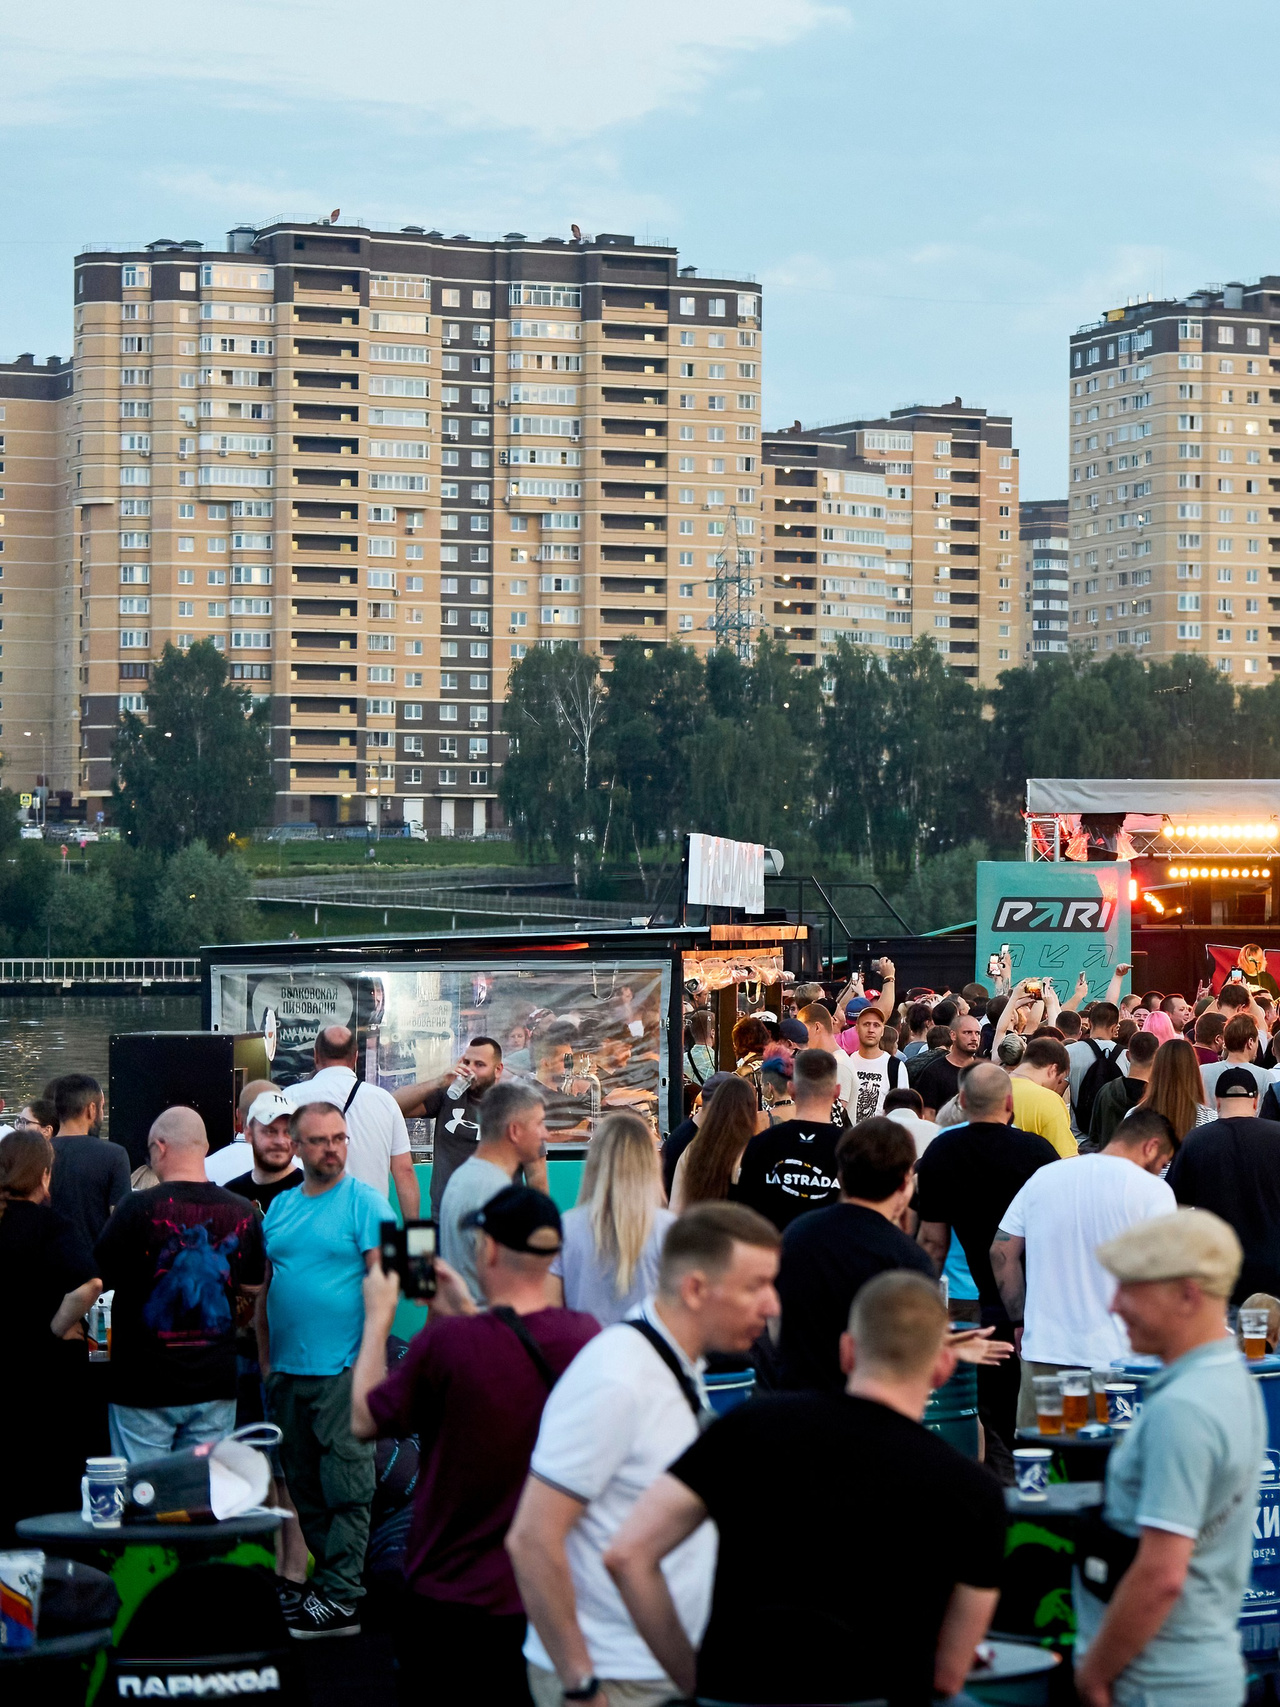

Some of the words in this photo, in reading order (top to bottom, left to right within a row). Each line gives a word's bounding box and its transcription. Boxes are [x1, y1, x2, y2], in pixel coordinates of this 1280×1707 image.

[996, 901, 1112, 928] PARI
[281, 986, 338, 1000] ВОЛКОВСКАЯ
[282, 1001, 336, 1014] ПИВОВАРНЯ
[765, 1173, 781, 1184] LA
[783, 1173, 841, 1189] STRADA
[117, 1665, 280, 1698] ПАРИХОД
